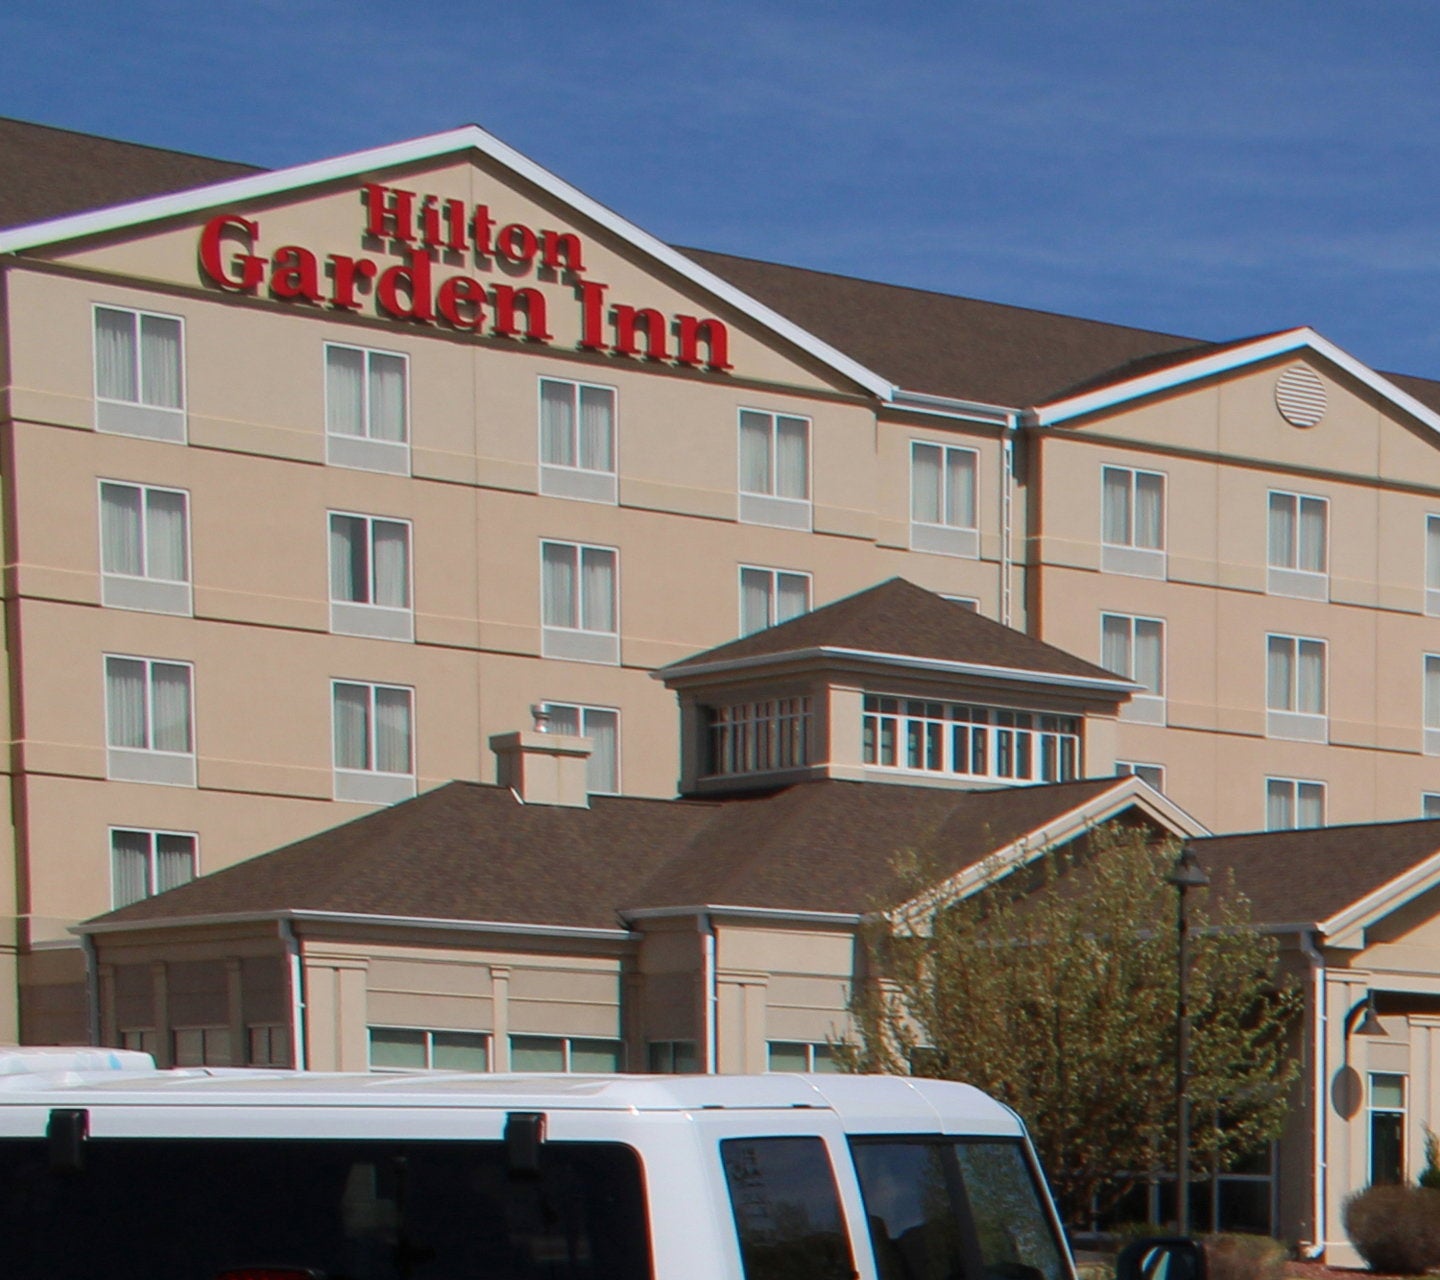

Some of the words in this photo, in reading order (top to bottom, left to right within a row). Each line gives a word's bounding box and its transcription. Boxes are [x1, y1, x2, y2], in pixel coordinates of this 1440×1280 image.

[362, 182, 586, 272] Hilton
[199, 214, 553, 343] Garden
[575, 279, 733, 372] Inn
